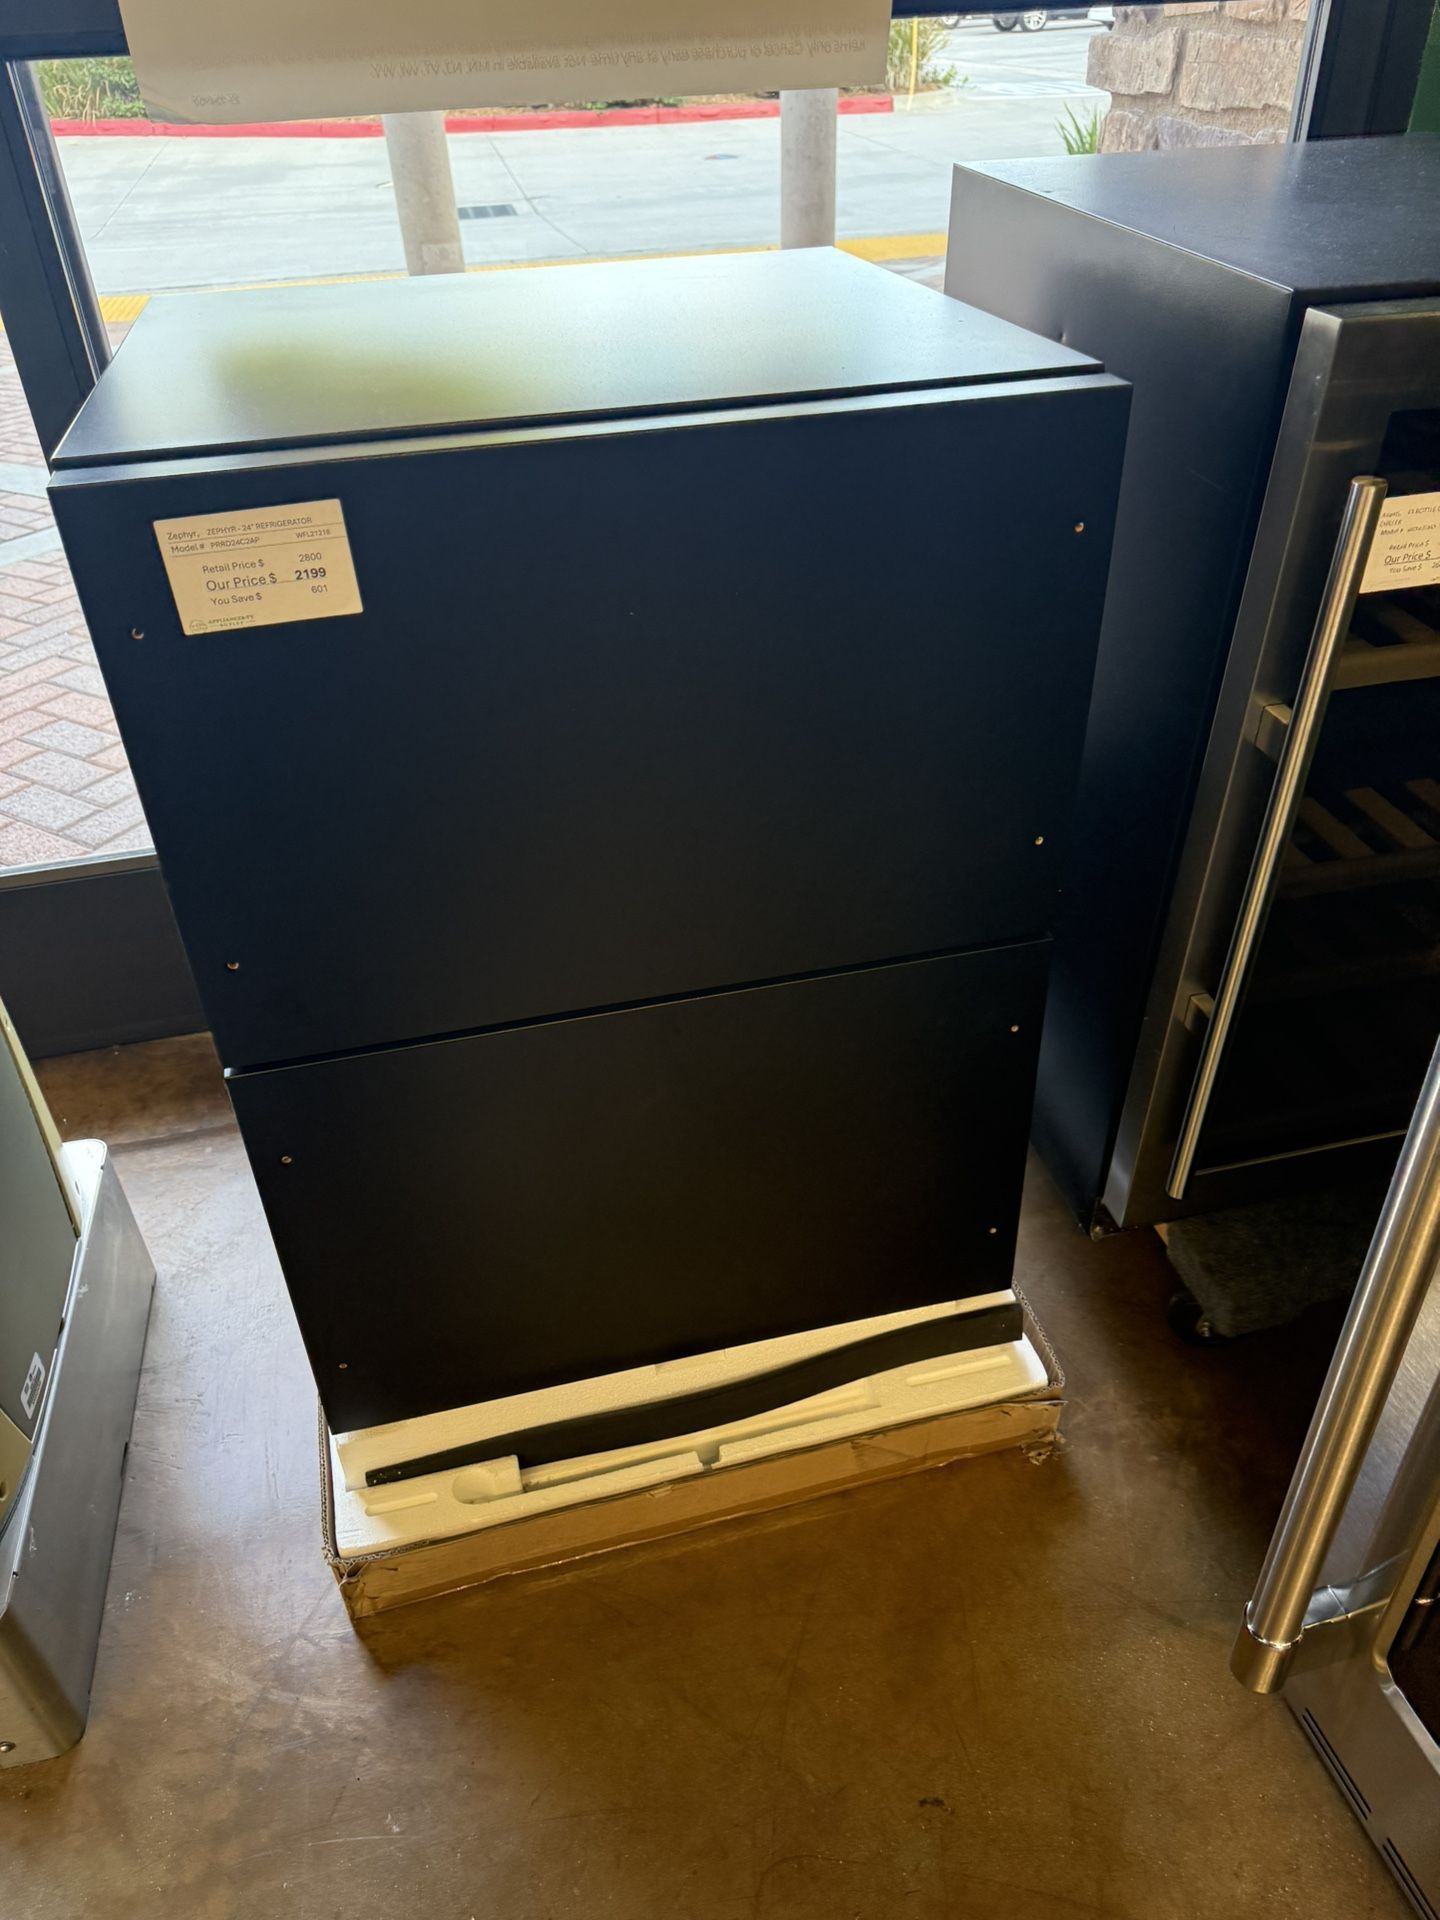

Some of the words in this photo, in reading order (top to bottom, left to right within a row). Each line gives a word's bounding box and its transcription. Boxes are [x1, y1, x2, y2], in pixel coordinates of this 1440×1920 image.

[166, 531, 201, 541] Zephyr,
[207, 526, 237, 536] ZEPHYR
[256, 517, 313, 530] REFRIGERATOR
[170, 543, 199, 554] Model
[1384, 555, 1401, 565] Our
[1403, 552, 1424, 562] Price
[202, 562, 231, 575] Retail
[232, 560, 257, 571] Price
[298, 552, 322, 563] 2800
[206, 578, 231, 592] Our
[233, 574, 266, 589] Price
[269, 572, 278, 584] $
[294, 567, 327, 581] 2199
[210, 594, 230, 606] You
[231, 592, 255, 604] Save
[311, 584, 328, 594] 601
